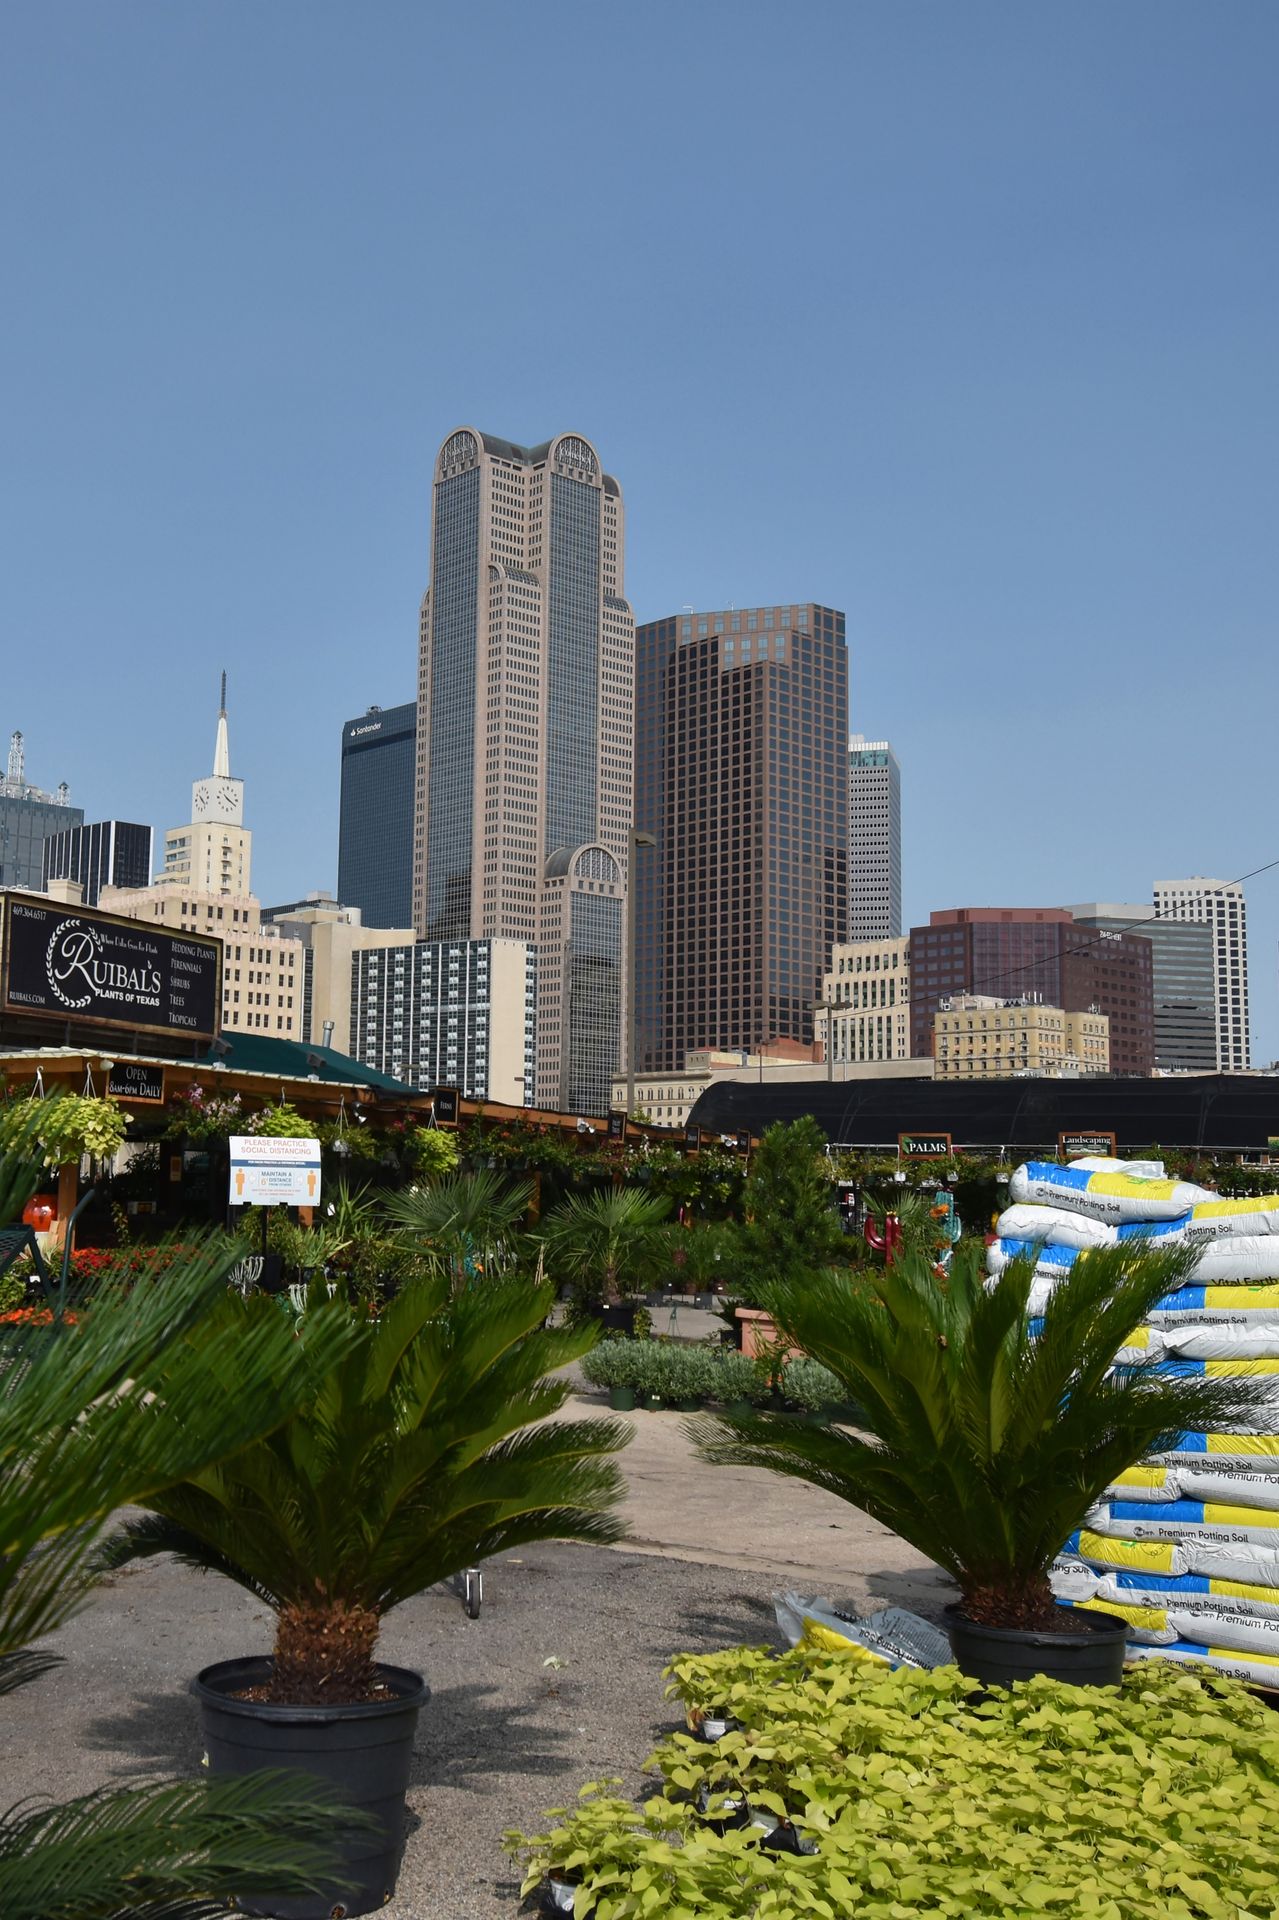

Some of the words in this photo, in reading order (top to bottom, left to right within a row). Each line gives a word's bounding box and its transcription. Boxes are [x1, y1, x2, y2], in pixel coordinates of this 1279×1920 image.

[356, 722, 382, 736] Santander
[13, 905, 47, 921] 469.364.6517
[197, 948, 216, 961] PLANTS
[9, 990, 46, 1005] RUIBALS.COM
[95, 989, 124, 1001] PLANTS
[125, 994, 135, 1003] OF
[136, 996, 160, 1007] TEXAS
[244, 1139, 272, 1147] PLEASE
[273, 1140, 308, 1148] PRACTICE
[1062, 1135, 1111, 1145] Landscaping
[241, 1146, 268, 1154] SOCIAL
[269, 1147, 312, 1155] DISTANCING
[909, 1142, 947, 1153] PALMS
[1107, 1202, 1120, 1213] Soil
[1187, 1226, 1216, 1238] Potting
[1218, 1223, 1234, 1234] Soil
[1243, 1276, 1278, 1287] Earth
[1164, 1316, 1198, 1327] Premium
[1164, 1457, 1200, 1468] Premium
[1202, 1459, 1234, 1471] Potting
[1235, 1460, 1253, 1471] Soil
[1158, 1527, 1197, 1539] Premium
[1199, 1530, 1230, 1543] Potting
[1231, 1533, 1249, 1543] Soil
[1166, 1598, 1202, 1609] Premium
[1236, 1605, 1254, 1616] Soil
[1216, 1611, 1262, 1629] Premium
[859, 1627, 876, 1645] Soil
[876, 1635, 905, 1660] Potting
[1234, 1668, 1251, 1680] Soil
